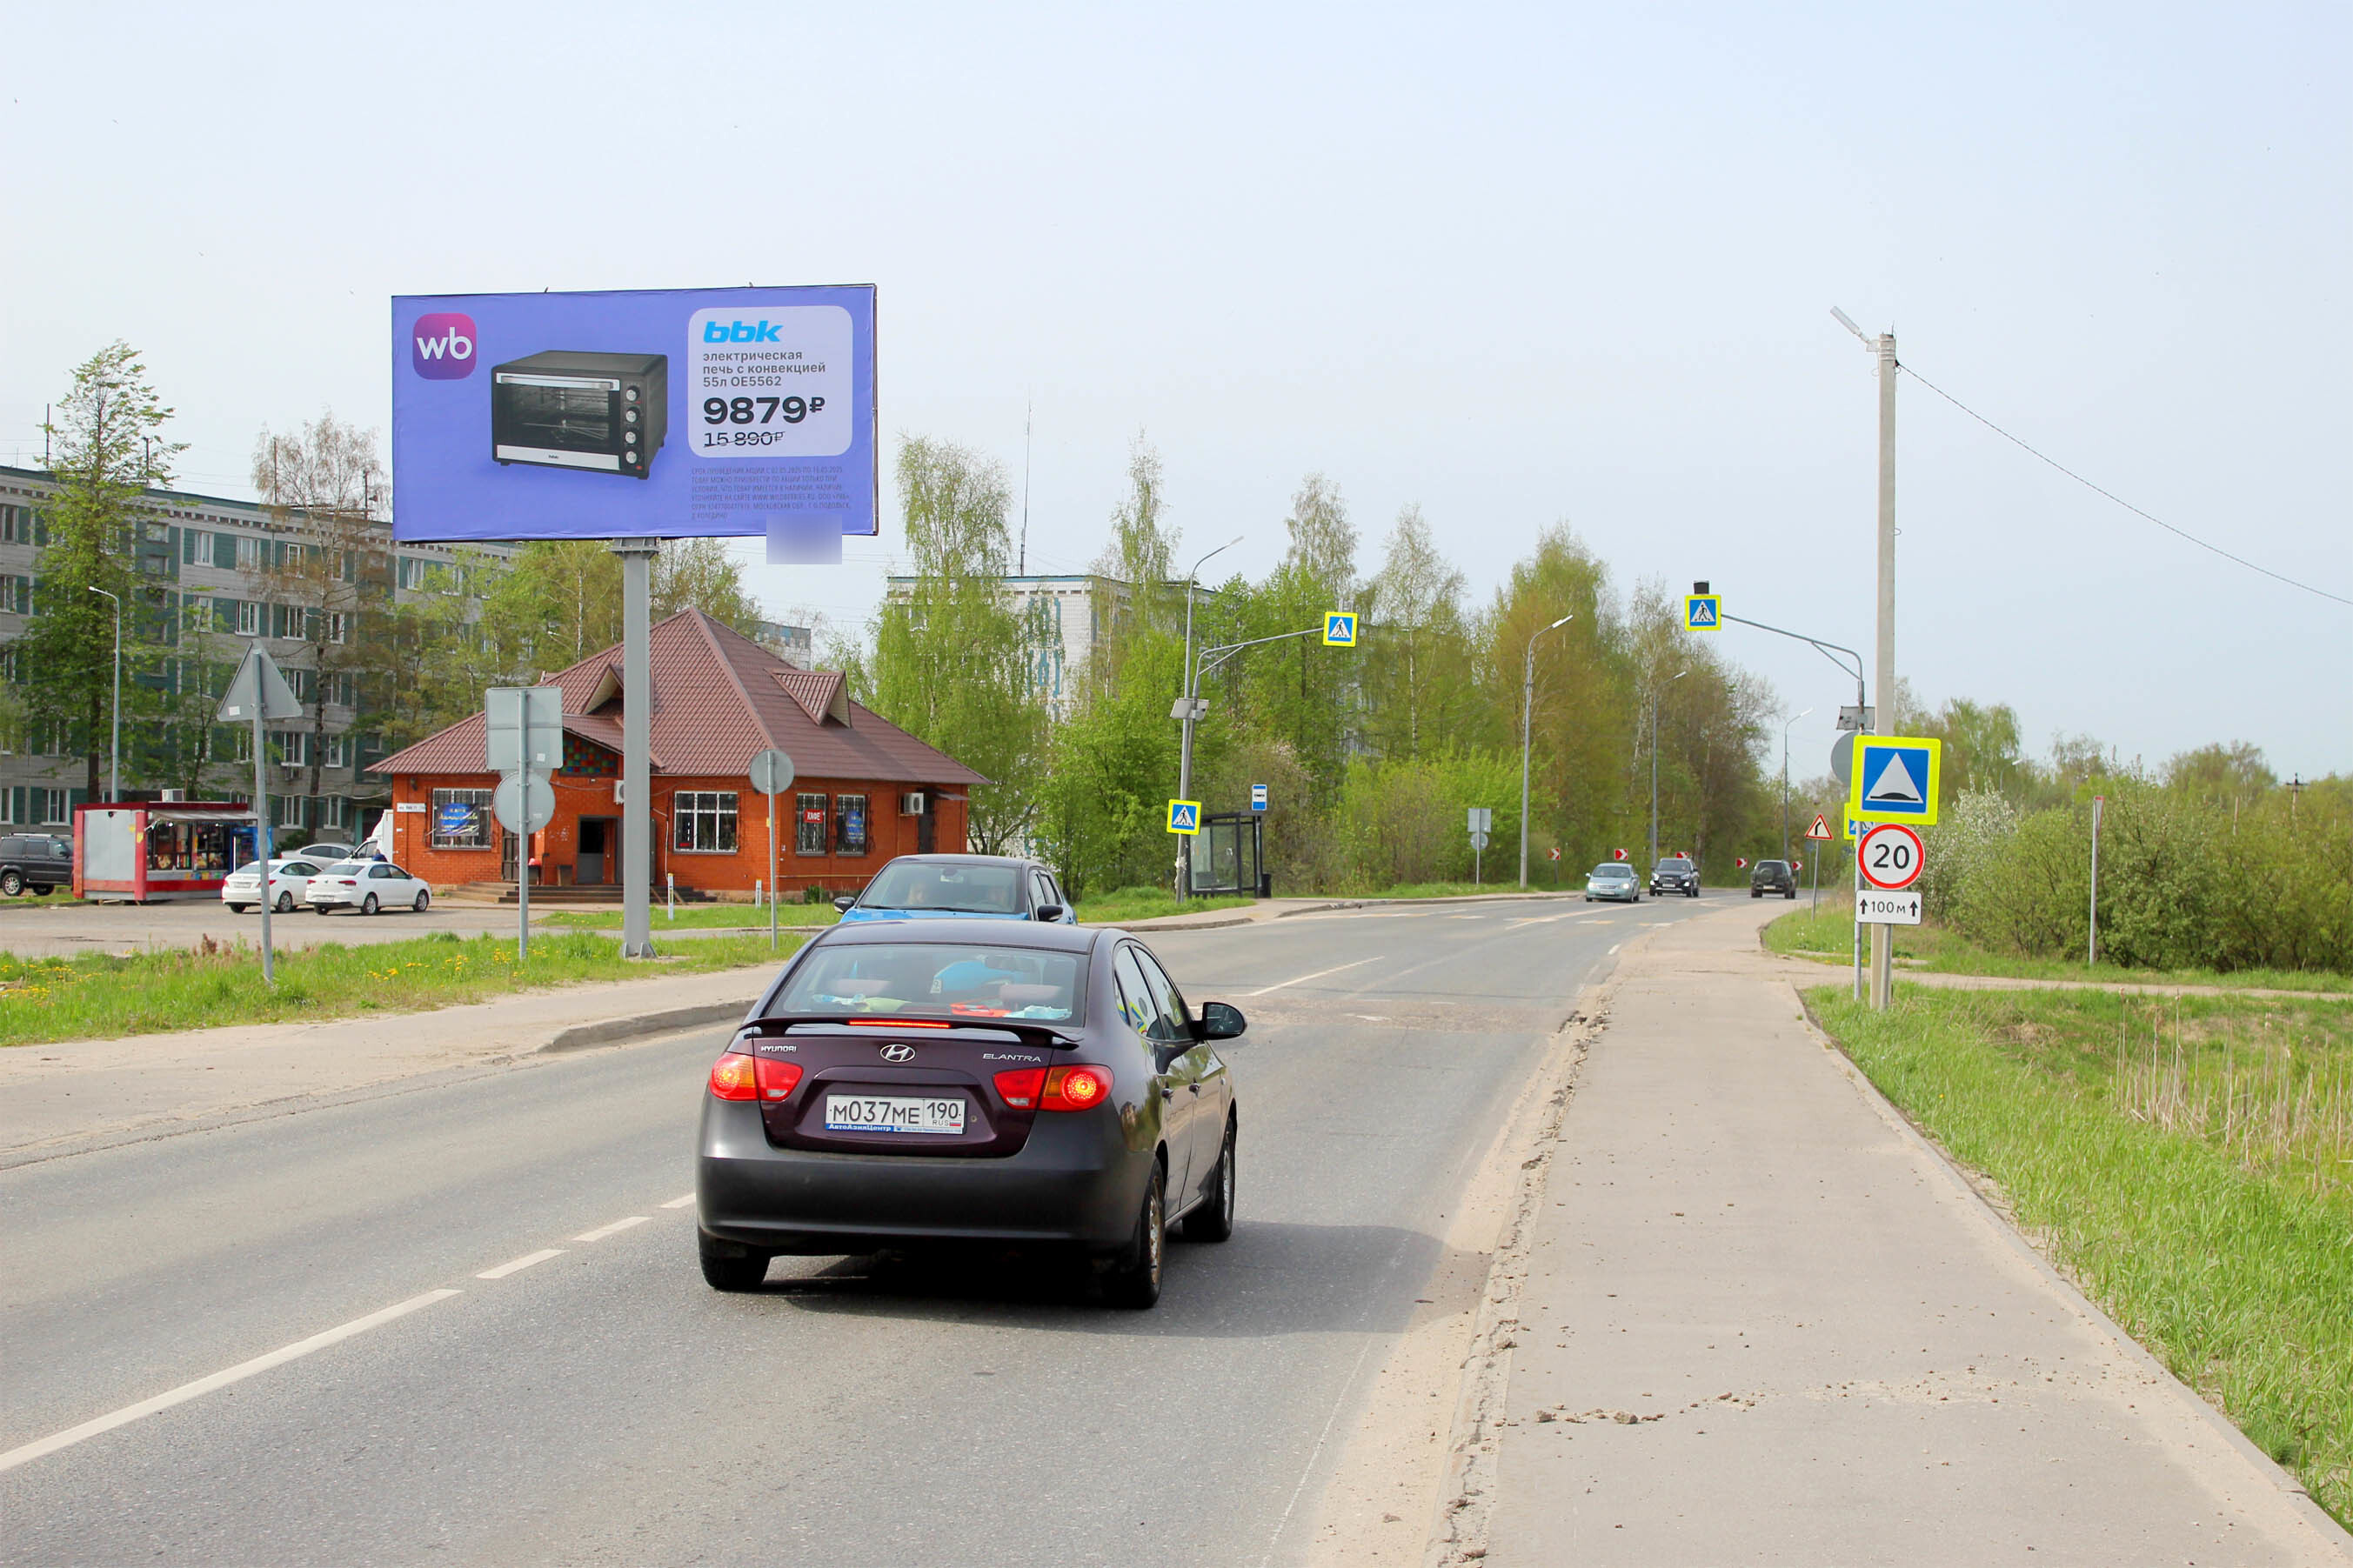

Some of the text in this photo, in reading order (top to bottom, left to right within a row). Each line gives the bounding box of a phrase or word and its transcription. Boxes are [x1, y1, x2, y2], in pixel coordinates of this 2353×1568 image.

[703, 320, 784, 344] bbk
[416, 326, 473, 360] wb
[703, 351, 803, 364] электрическая
[703, 362, 826, 376] печь с конвекцией
[703, 376, 782, 387] 55л OE5562
[1873, 844, 1909, 869] 20
[982, 1053, 1041, 1063] ELANTRA
[832, 1100, 959, 1124] М037МЕ 190
